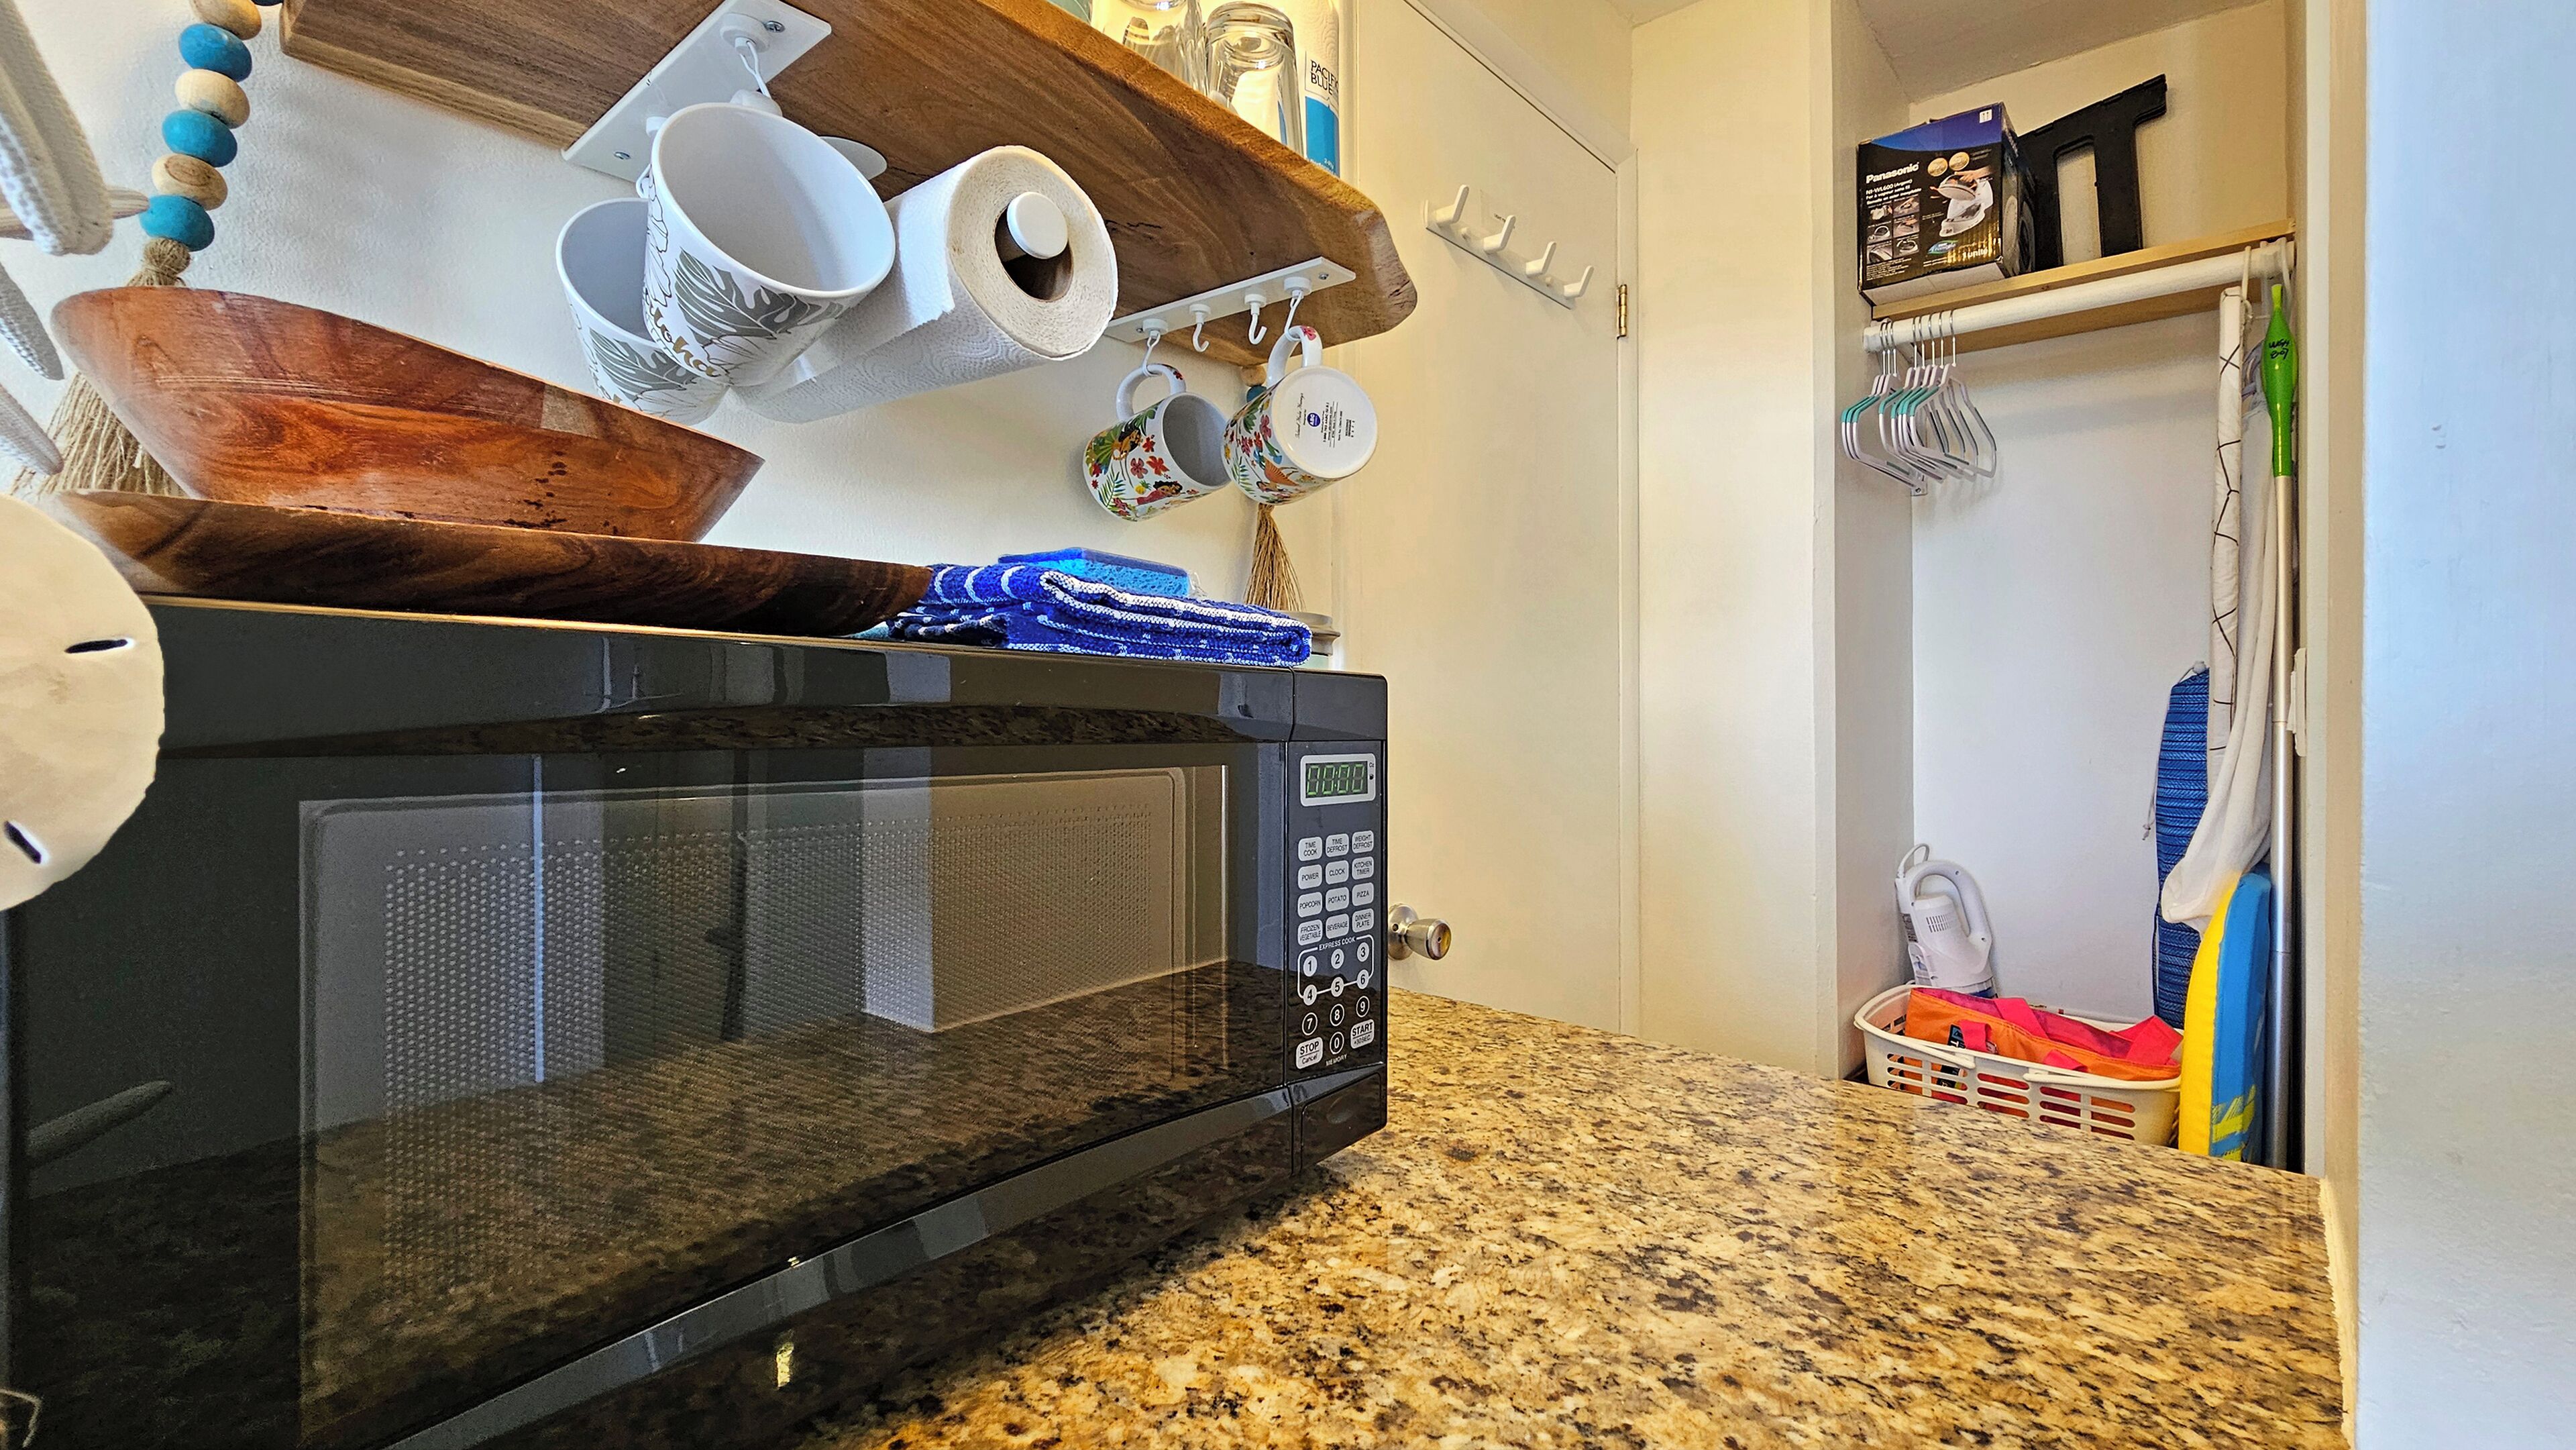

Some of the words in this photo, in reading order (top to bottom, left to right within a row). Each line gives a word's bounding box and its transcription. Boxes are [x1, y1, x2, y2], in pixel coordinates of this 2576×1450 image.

[1310, 71, 1333, 95] BLUE
[1866, 163, 1919, 184] Panasonic
[1306, 764, 1364, 796] 00:00
[1354, 834, 1371, 842] WEIGHT
[1305, 841, 1316, 849] TIME
[1327, 844, 1348, 853] DEFROST
[1353, 841, 1373, 849] DEFROST
[1303, 848, 1318, 857] COOK
[1354, 860, 1373, 868] KITCHEN
[1301, 872, 1319, 881] POWER
[1329, 868, 1345, 876] CLOCK
[1328, 894, 1347, 904] POTATO
[1299, 900, 1321, 909] POPCORN
[1355, 913, 1371, 921] DINNER
[1300, 924, 1320, 933] FROZEN
[1327, 921, 1348, 931] BEVERAGE
[1356, 920, 1370, 928] PLATE
[1299, 931, 1321, 941] VEGETABLE
[1319, 939, 1341, 950] EXPRESS
[1342, 936, 1356, 945] COOK
[1360, 947, 1366, 957] 3
[1335, 953, 1340, 964] 2
[1308, 960, 1312, 972] 1
[1360, 974, 1365, 984] 6
[1334, 982, 1340, 992] 5
[1307, 989, 1313, 1000] 4
[1360, 1001, 1365, 1012] 9
[1334, 1009, 1340, 1021] 8
[1307, 1018, 1313, 1029] 7
[1352, 1022, 1373, 1037] START
[1300, 1041, 1320, 1055] STOP
[1334, 1037, 1340, 1049] 0
[1301, 1053, 1318, 1064] Cancel
[1326, 1053, 1348, 1066] MEMORY
